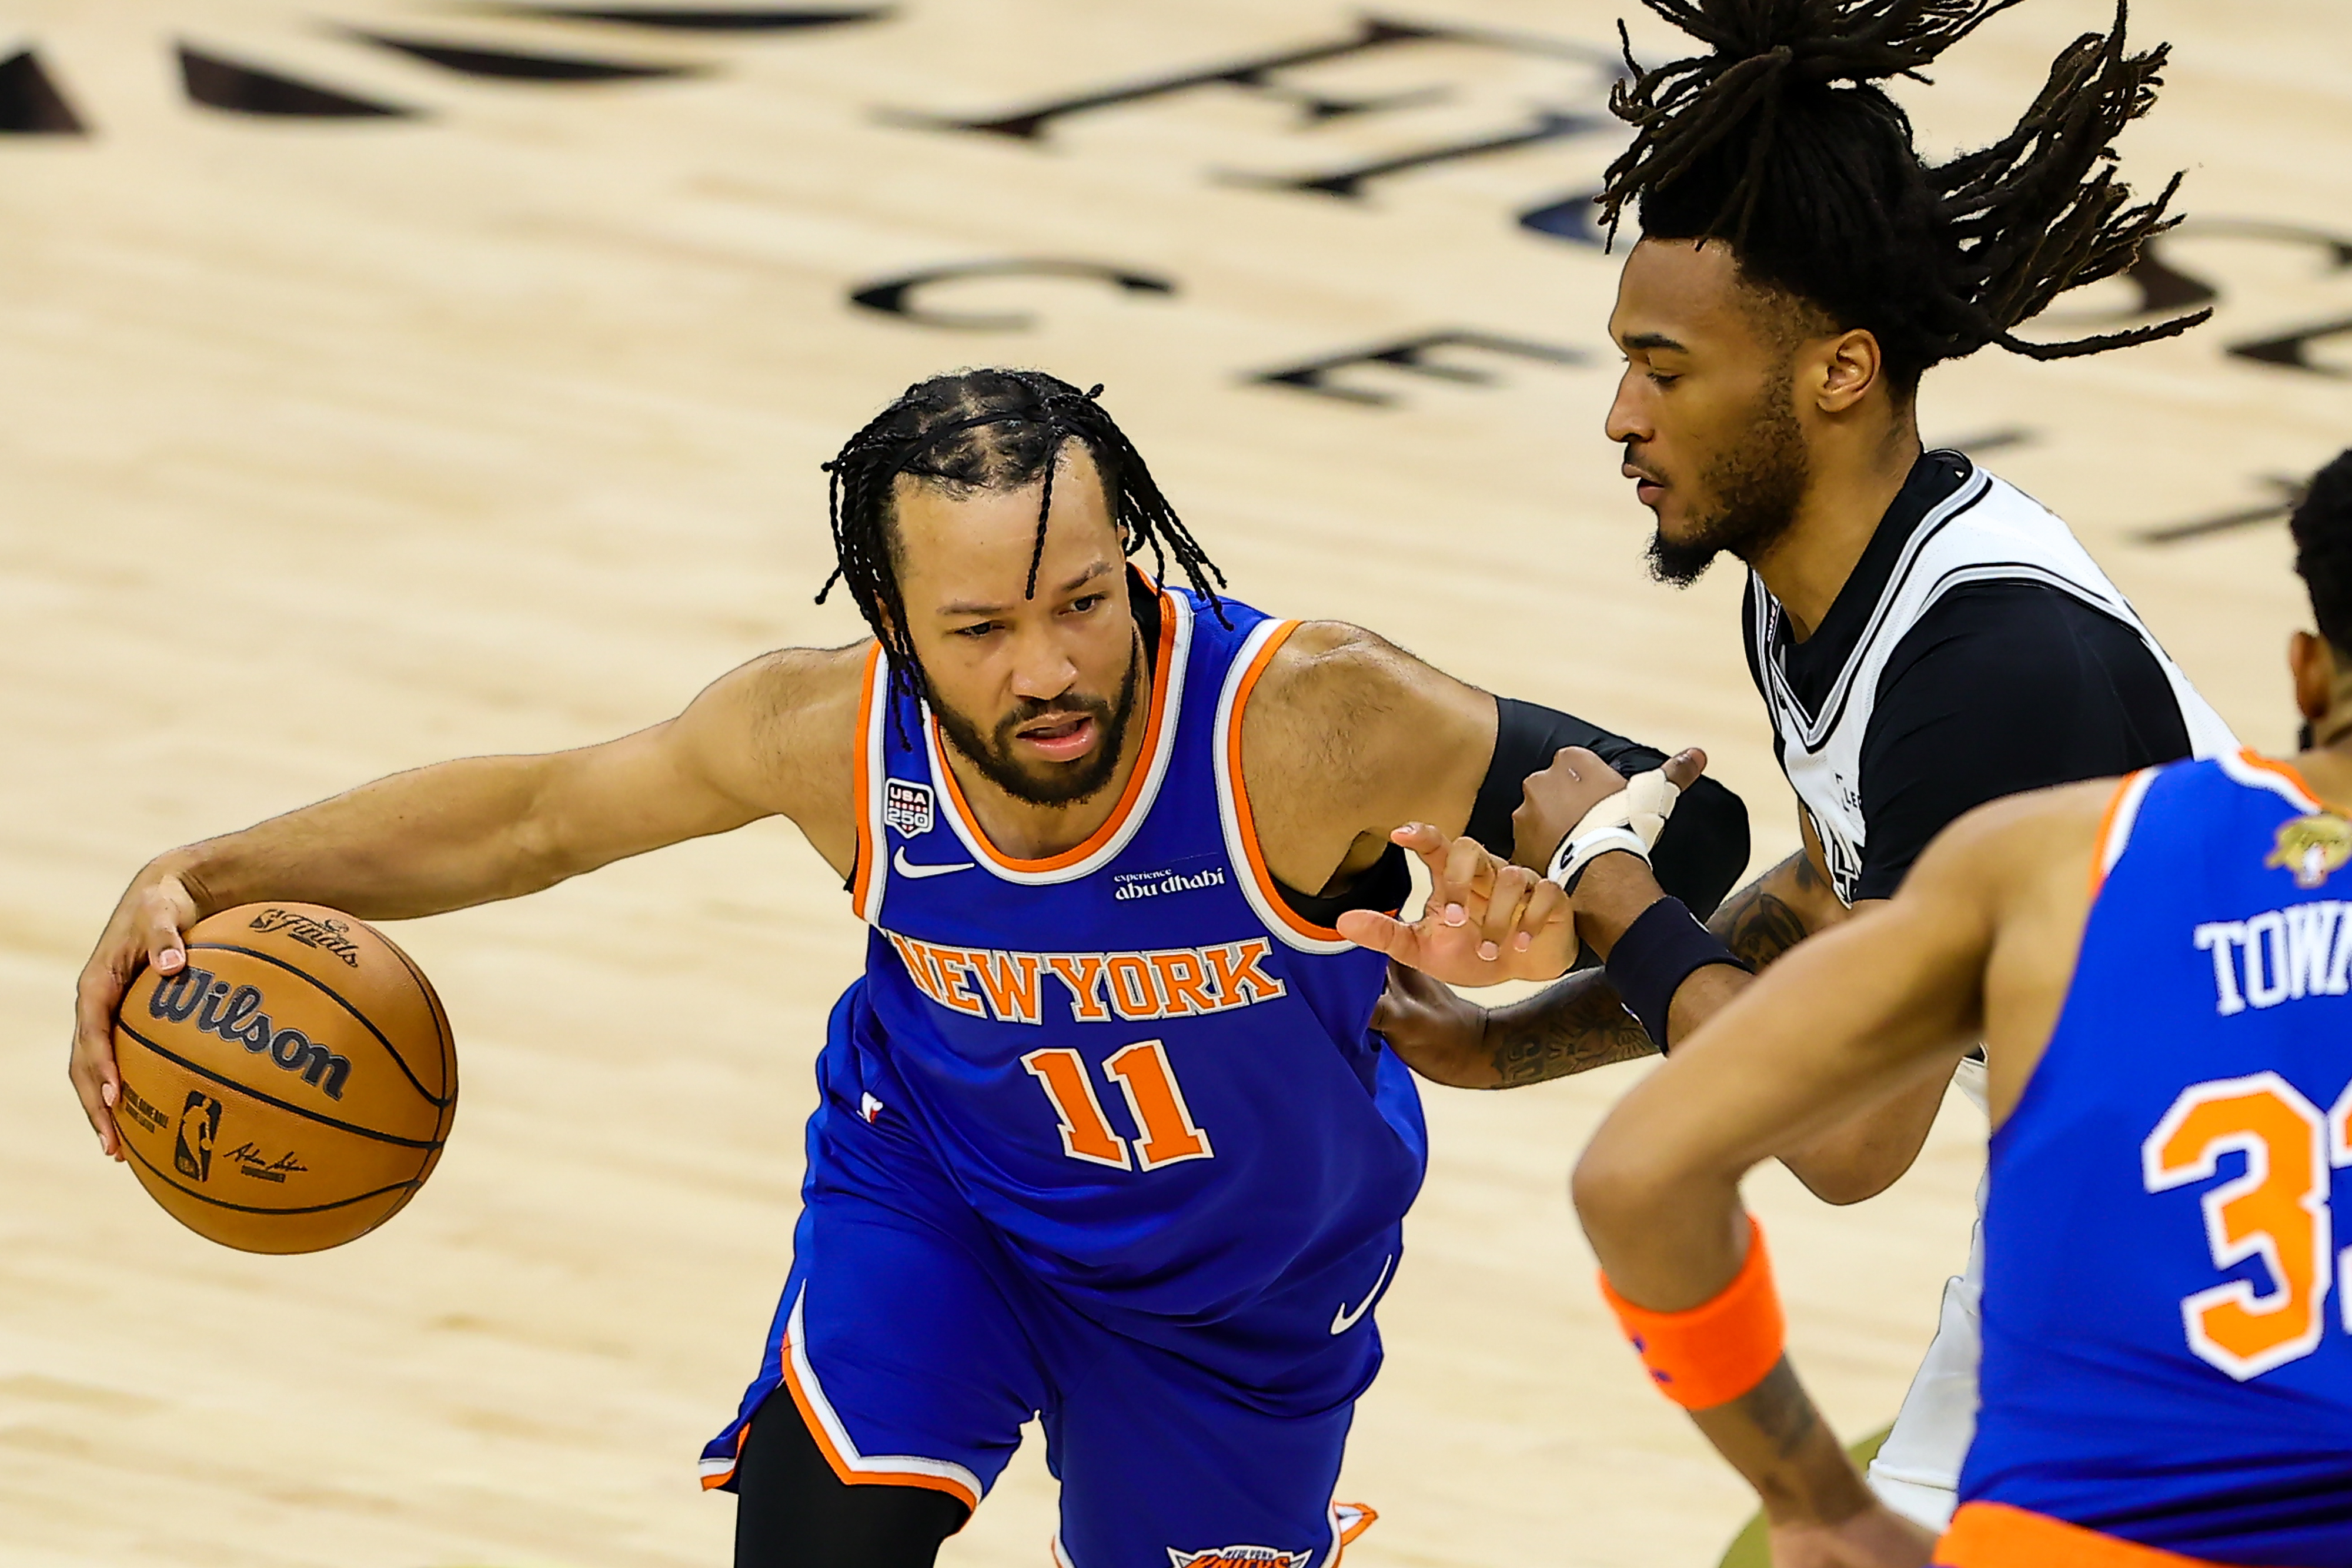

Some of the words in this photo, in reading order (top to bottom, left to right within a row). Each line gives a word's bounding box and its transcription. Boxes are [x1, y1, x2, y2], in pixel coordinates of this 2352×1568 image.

[888, 807, 928, 827] 250
[890, 787, 927, 805] USA
[1114, 868, 1172, 882] experience
[1115, 882, 1158, 900] abu
[1161, 867, 1225, 893] dhabi
[255, 914, 358, 968] Finals
[884, 929, 1042, 1025] NEW
[1042, 936, 1288, 1022] YORK
[149, 967, 352, 1102] Wilson
[1020, 1039, 1215, 1172] 11
[2140, 1069, 2352, 1383] 3
